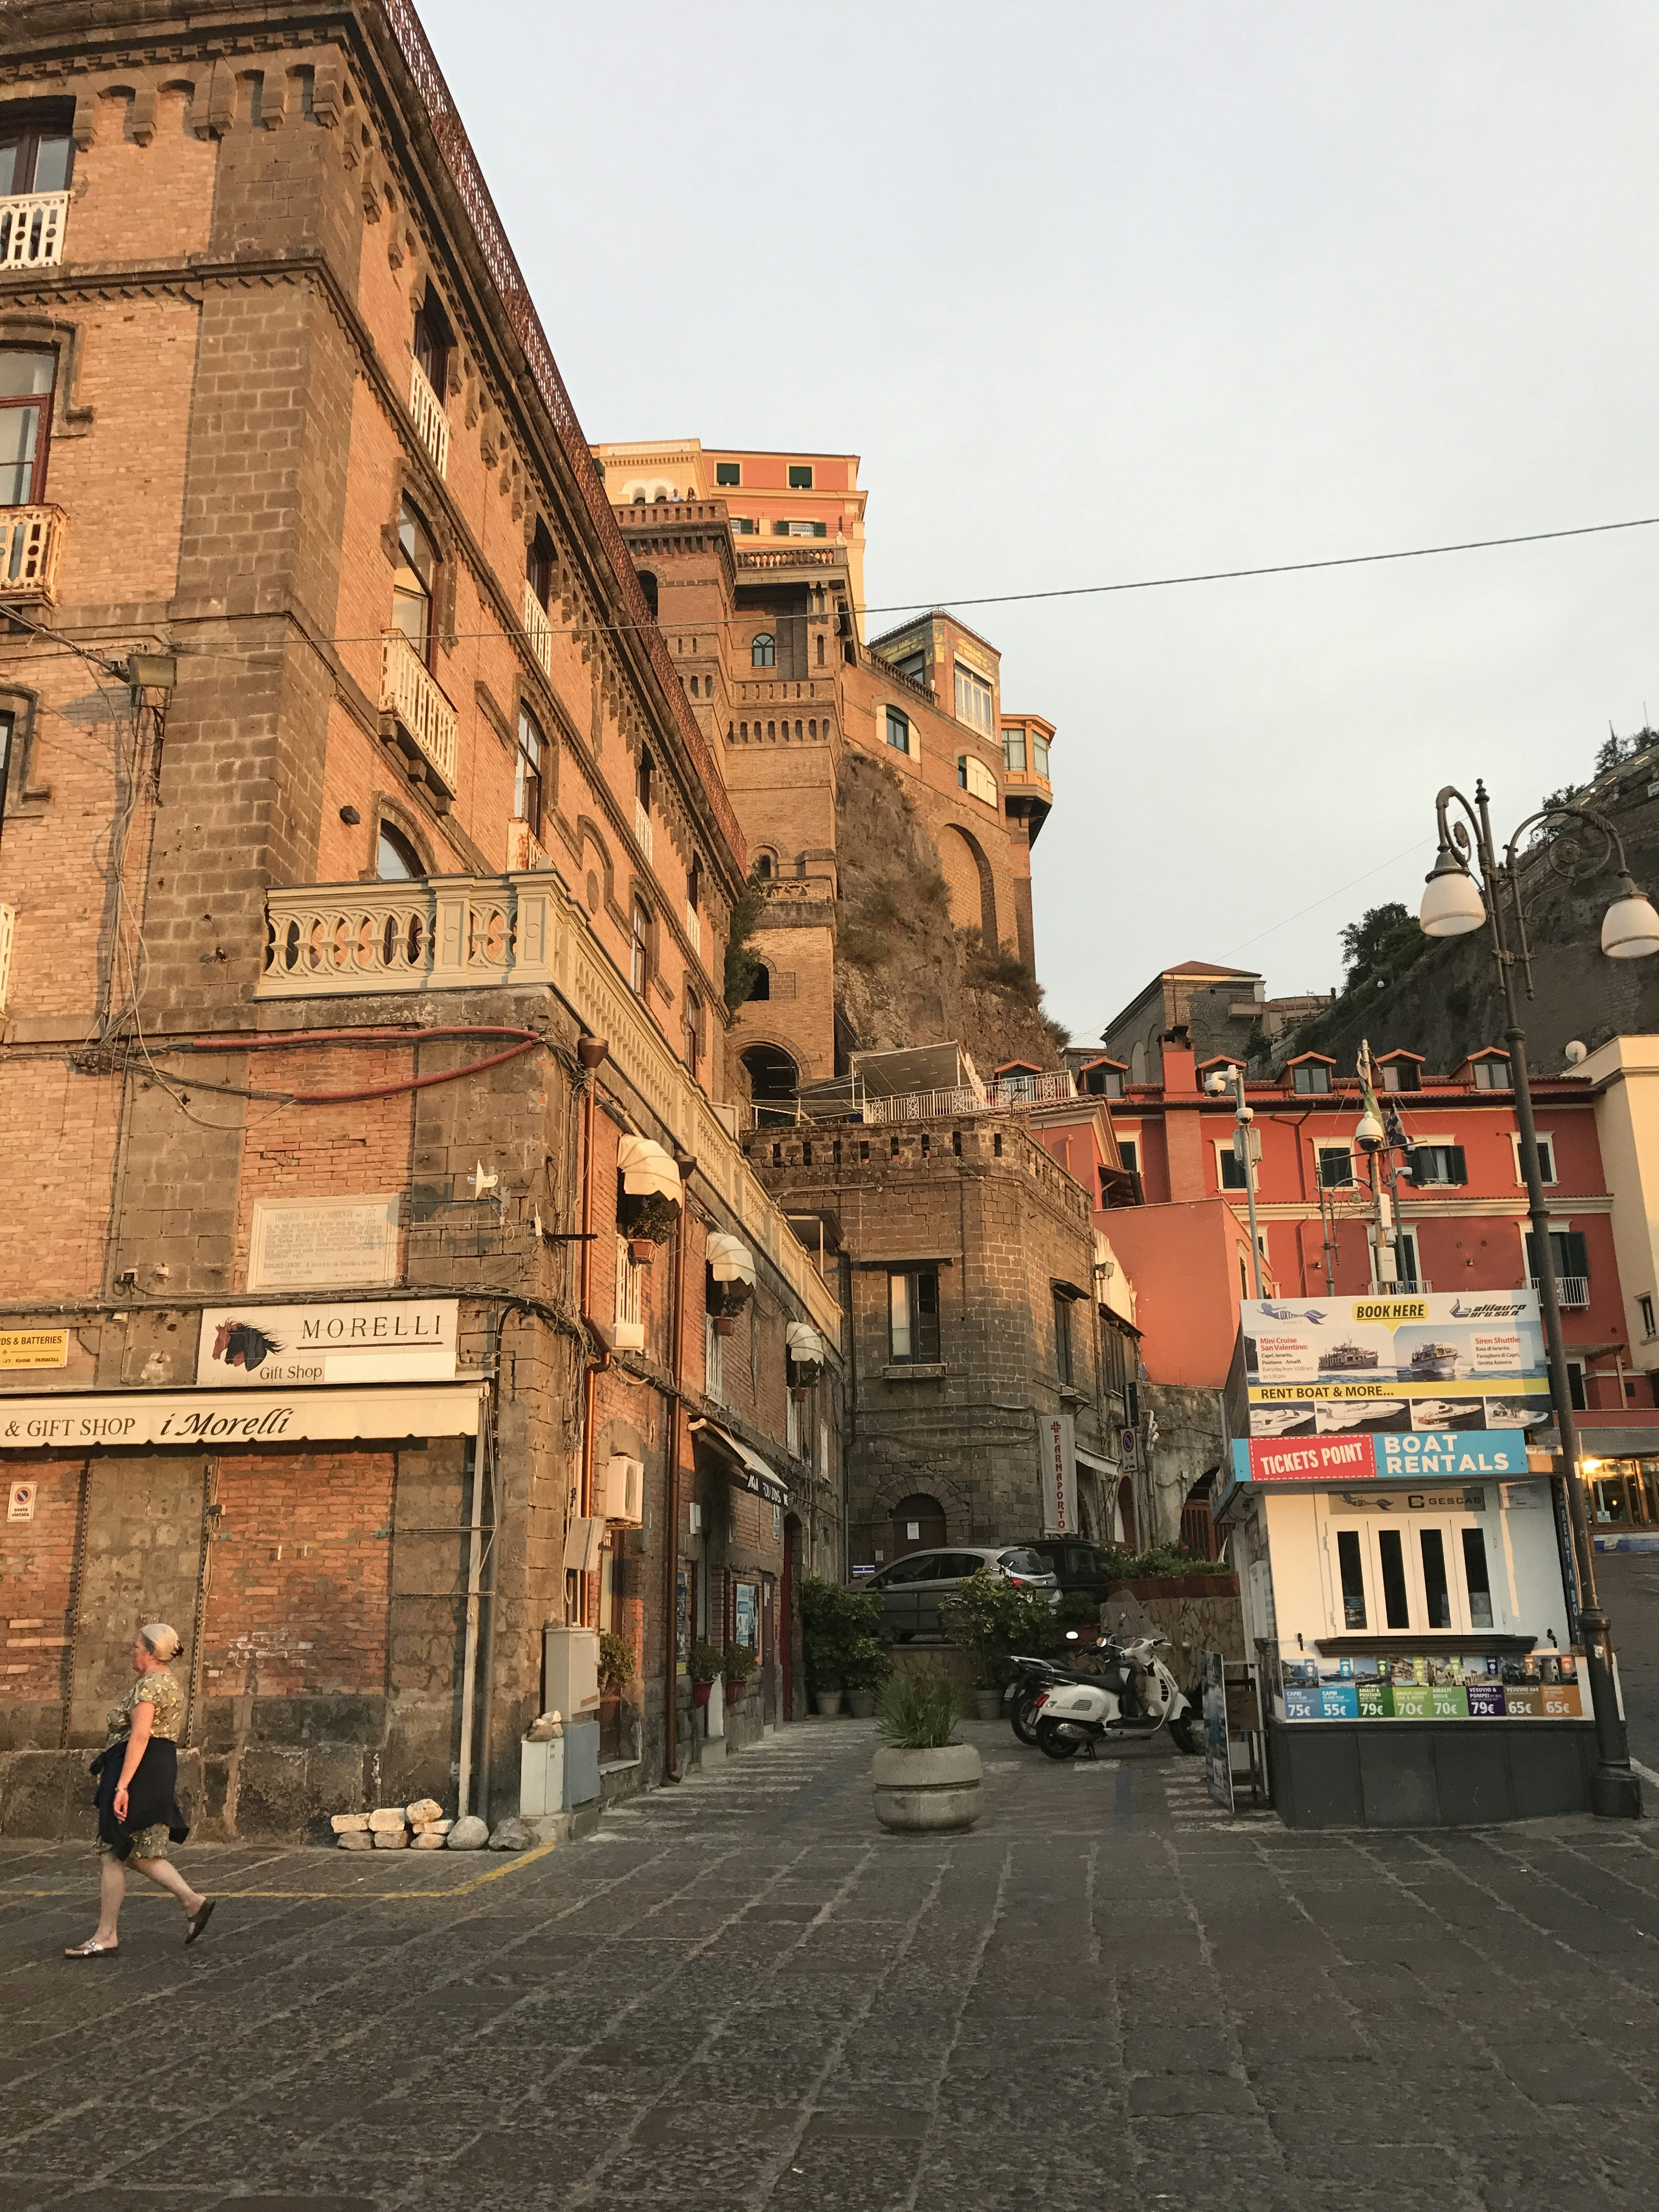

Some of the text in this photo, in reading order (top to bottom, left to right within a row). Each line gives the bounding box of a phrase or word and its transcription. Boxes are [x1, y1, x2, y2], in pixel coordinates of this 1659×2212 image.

[1357, 1304, 1425, 1318] BOOK HERE
[302, 1316, 441, 1339] MORELLI
[21, 1336, 62, 1345] BATTERIES
[259, 1365, 323, 1381] Gift Shop
[1261, 1386, 1394, 1399] RENT BOAT & MORE...
[4, 1418, 20, 1437] &
[27, 1419, 75, 1437] GIFT
[80, 1418, 136, 1436] SHOP
[174, 1408, 294, 1436] Morelli
[1385, 1434, 1458, 1454] BOAT
[1260, 1443, 1363, 1475] TICKETS POINT
[1386, 1453, 1509, 1474] RENTALS
[1054, 1435, 1065, 1529] FARMAPORTO
[1429, 1497, 1481, 1505] GESCAB
[1571, 1589, 1581, 1644] BOT
[1288, 1704, 1311, 1716] 75€
[1324, 1703, 1346, 1716] 55€
[1361, 1703, 1384, 1716] 79€
[1397, 1703, 1424, 1715] 70€
[1434, 1702, 1457, 1714] 70€
[1471, 1702, 1495, 1714] 79€
[1508, 1701, 1532, 1714] 65€
[1546, 1701, 1570, 1714] 65€
